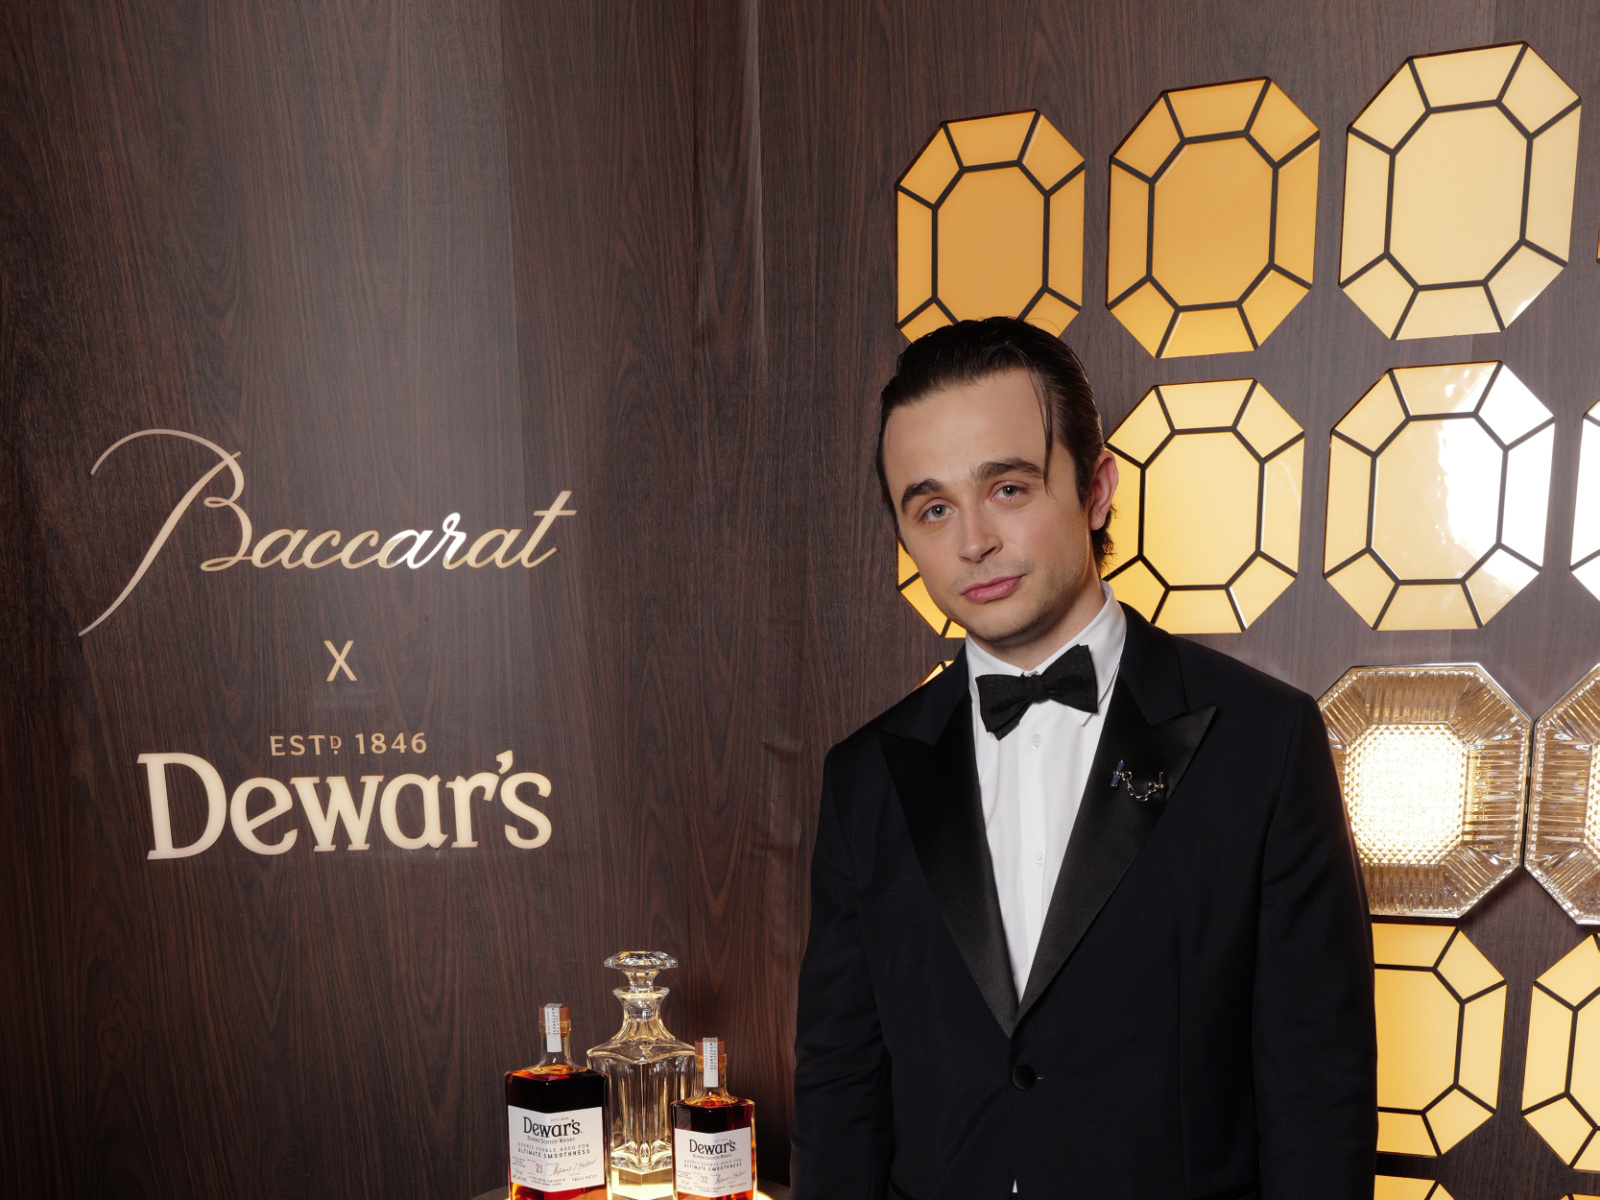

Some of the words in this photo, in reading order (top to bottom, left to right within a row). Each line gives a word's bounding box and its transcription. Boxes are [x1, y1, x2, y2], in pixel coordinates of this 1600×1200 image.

[78, 429, 577, 636] Baccarat
[354, 732, 427, 755] 1846
[136, 750, 553, 861] Dewar's
[522, 1116, 581, 1138] Dewar's
[518, 1147, 541, 1158] ULTIMATE
[543, 1148, 591, 1159] SMOOTHNESS
[688, 1138, 736, 1155] Dewar's
[535, 1163, 543, 1174] 21
